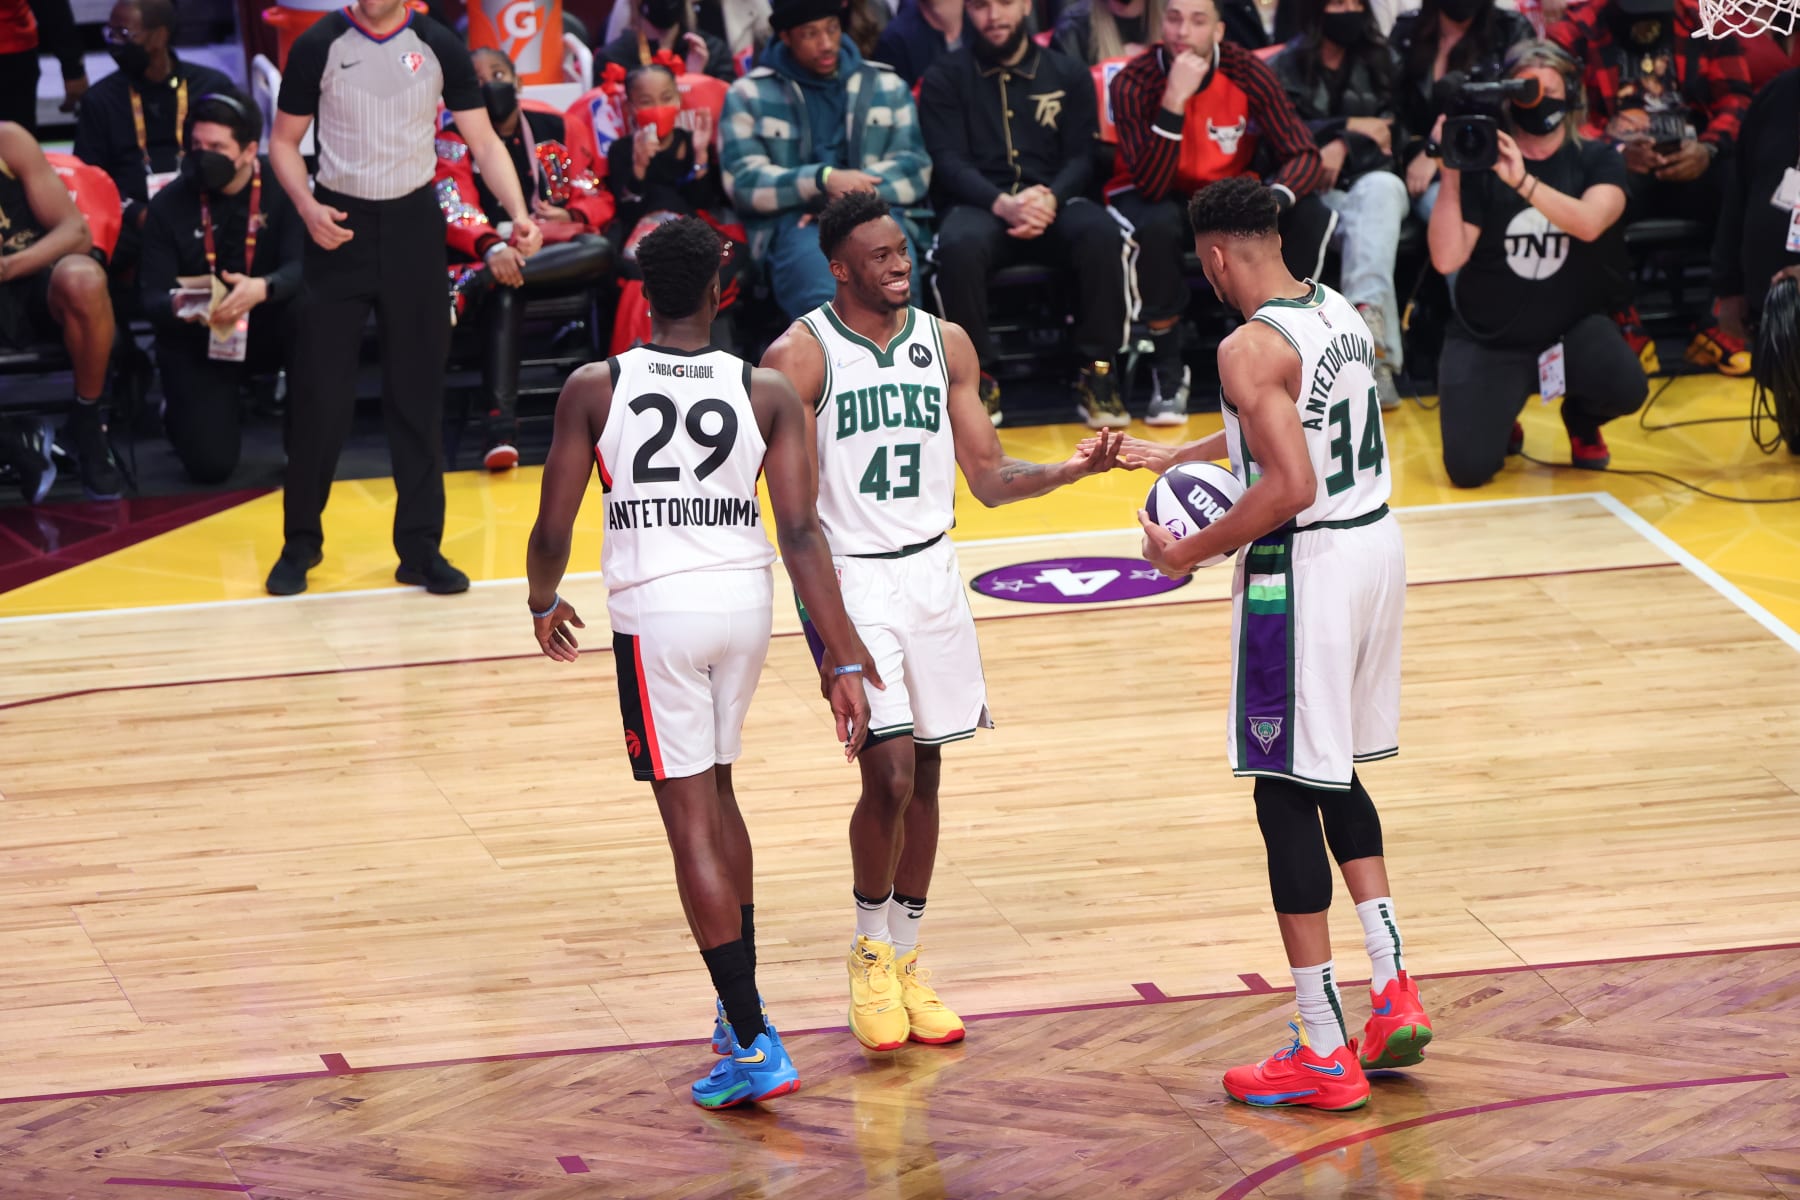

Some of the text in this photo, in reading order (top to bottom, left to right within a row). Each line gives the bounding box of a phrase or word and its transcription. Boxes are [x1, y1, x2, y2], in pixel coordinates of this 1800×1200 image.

[504, 1, 536, 38] G
[628, 393, 738, 484] 29
[836, 382, 941, 440] BUCKS
[1325, 385, 1384, 497] 34
[859, 443, 921, 501] 43
